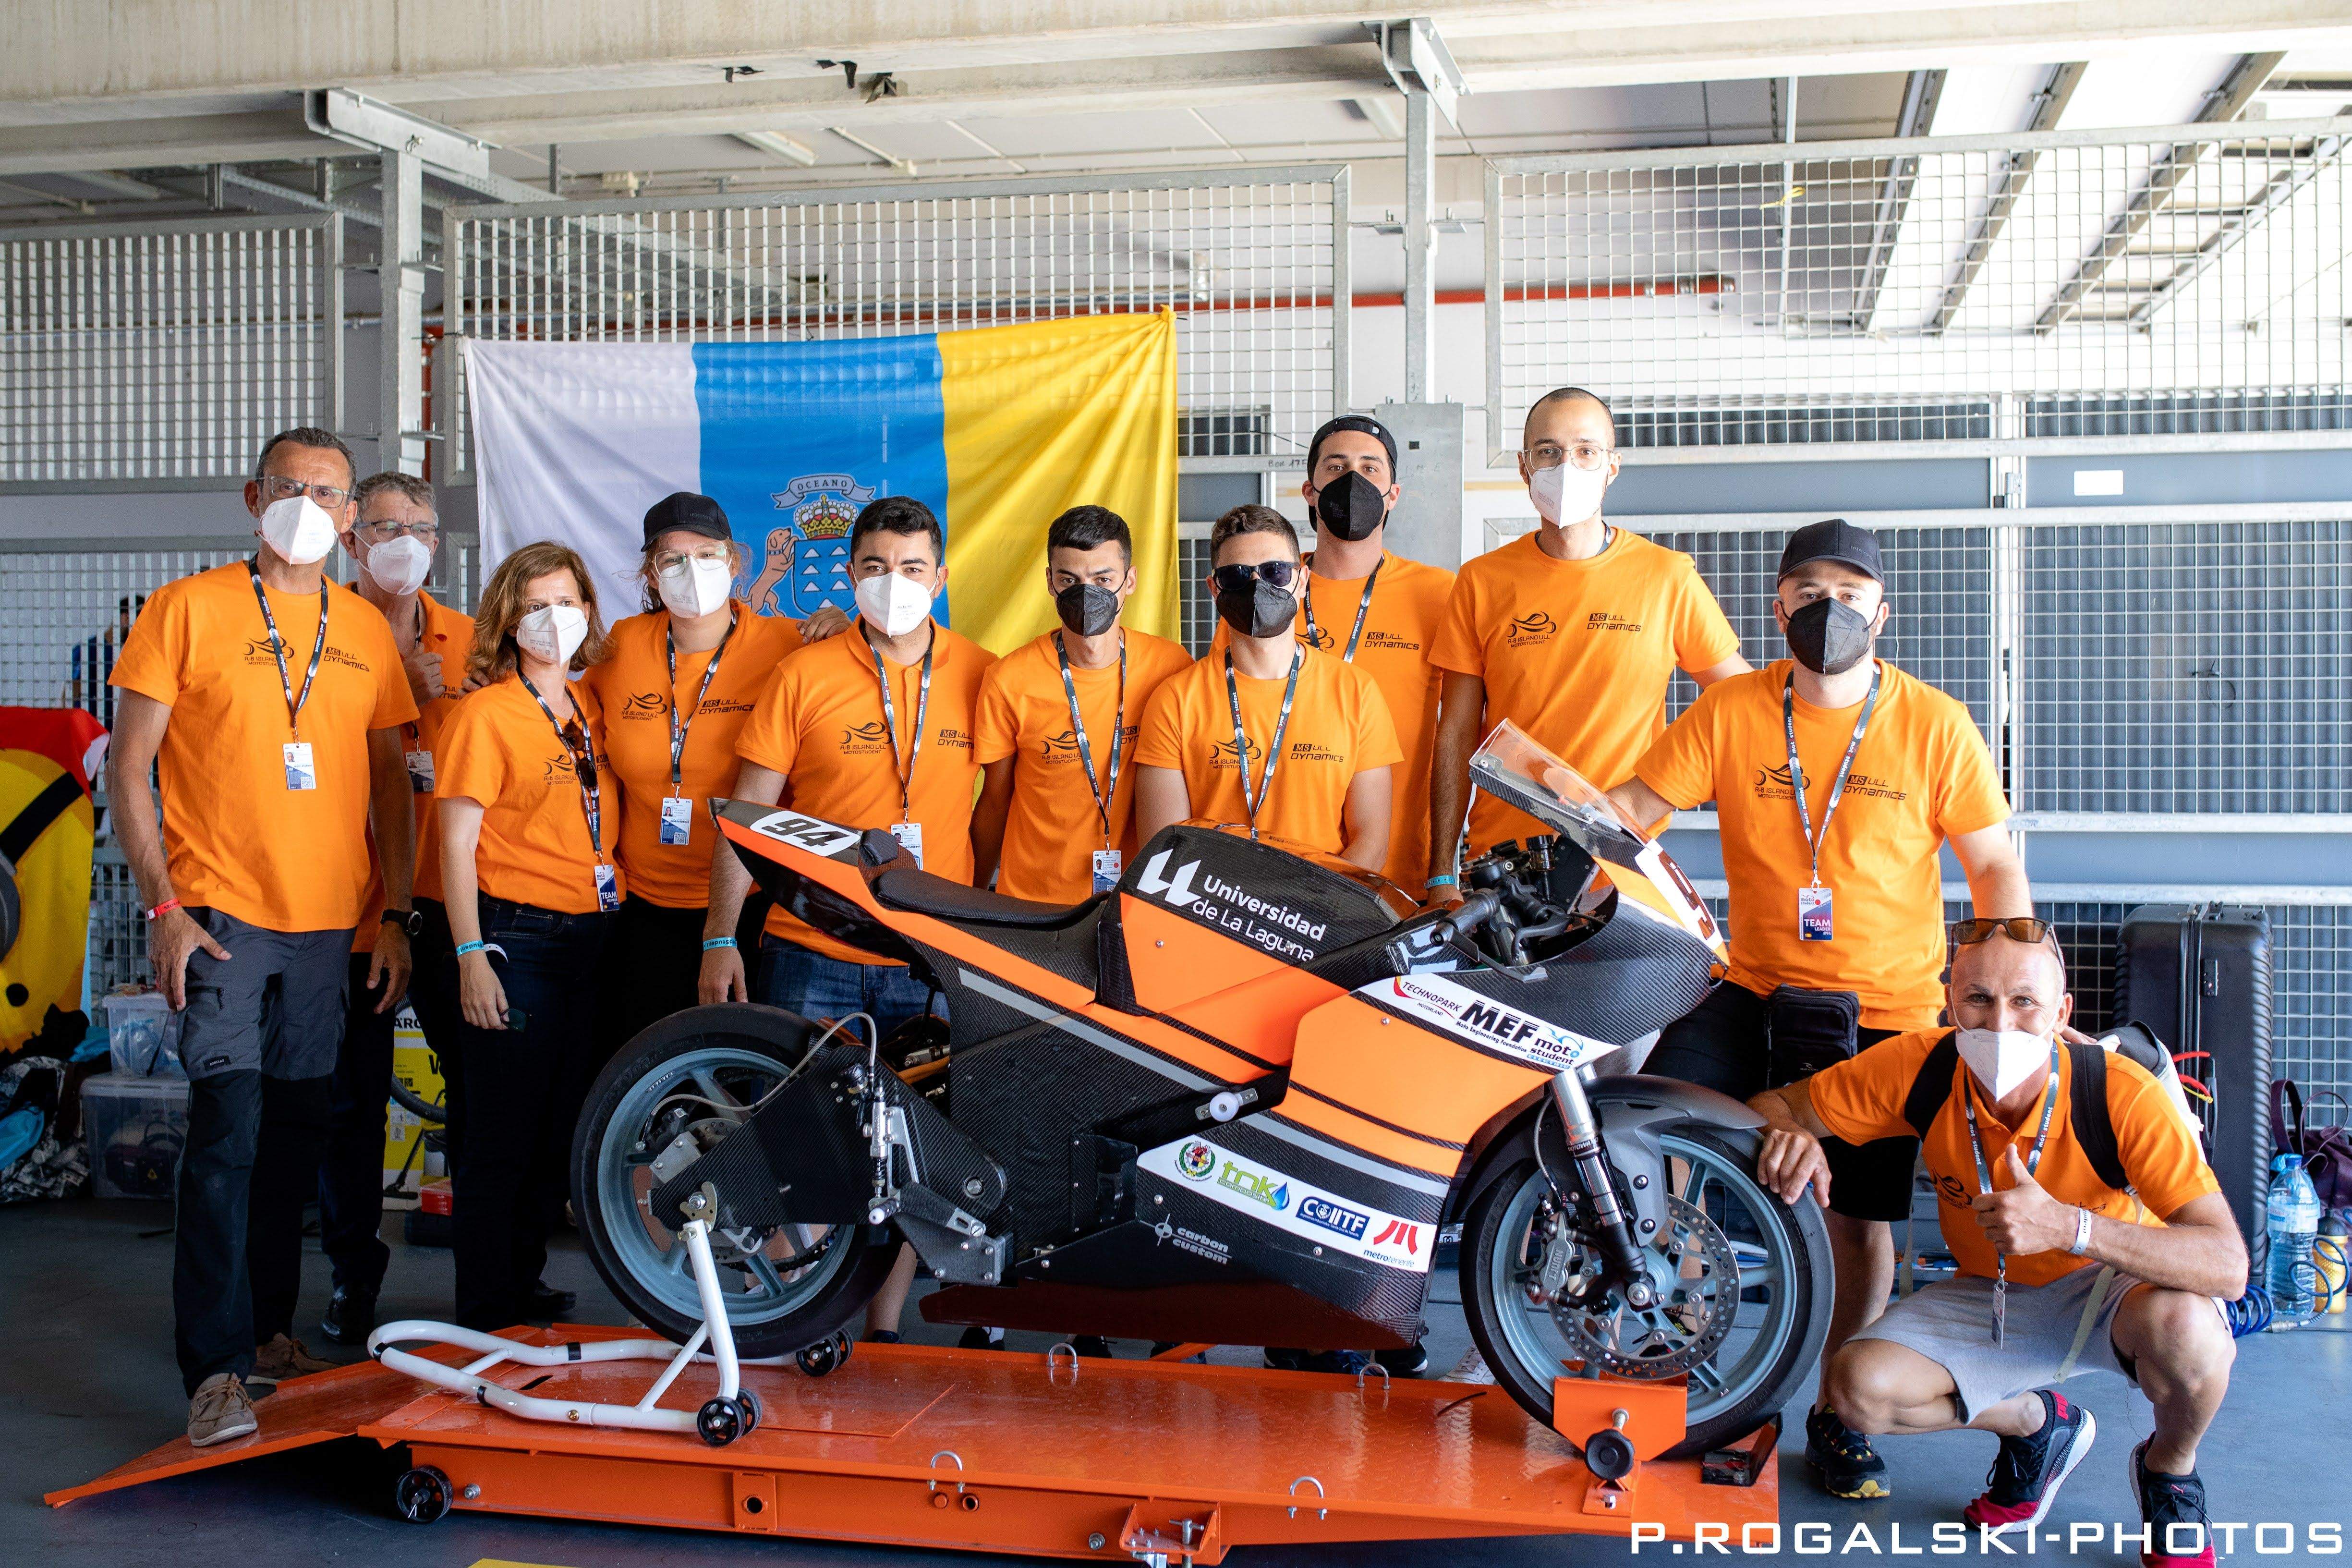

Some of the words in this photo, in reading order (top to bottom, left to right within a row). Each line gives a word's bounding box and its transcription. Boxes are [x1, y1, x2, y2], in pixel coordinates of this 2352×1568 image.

[798, 479, 847, 490] OCEANO
[1124, 727, 1136, 735] MS
[1849, 775, 1866, 784] MS
[1868, 778, 1888, 787] ULL
[761, 818, 850, 847] 94
[601, 891, 617, 899] TEAM
[1204, 875, 1326, 942] Universidad
[1193, 899, 1218, 920] de
[1220, 909, 1242, 933] La
[1245, 920, 1314, 962] Laguna
[1804, 919, 1831, 927] TEAM
[1403, 981, 1463, 1012] TECHNOPARK
[1416, 1002, 1443, 1016] MOTORLAND
[1460, 999, 1540, 1043] MEF
[1455, 1020, 1468, 1030] Moto
[1469, 1026, 1500, 1044] Engineering
[1500, 1039, 1527, 1053] Foundation
[1536, 1037, 1580, 1057] moto
[1529, 1047, 1575, 1065] student
[1219, 1178, 1270, 1203] composite
[1222, 1160, 1278, 1206] tnk
[1303, 1199, 1366, 1232] COIITF
[1173, 1238, 1227, 1264] custom
[1177, 1227, 1228, 1253] carbon
[1363, 1249, 1415, 1268] metrotenerife
